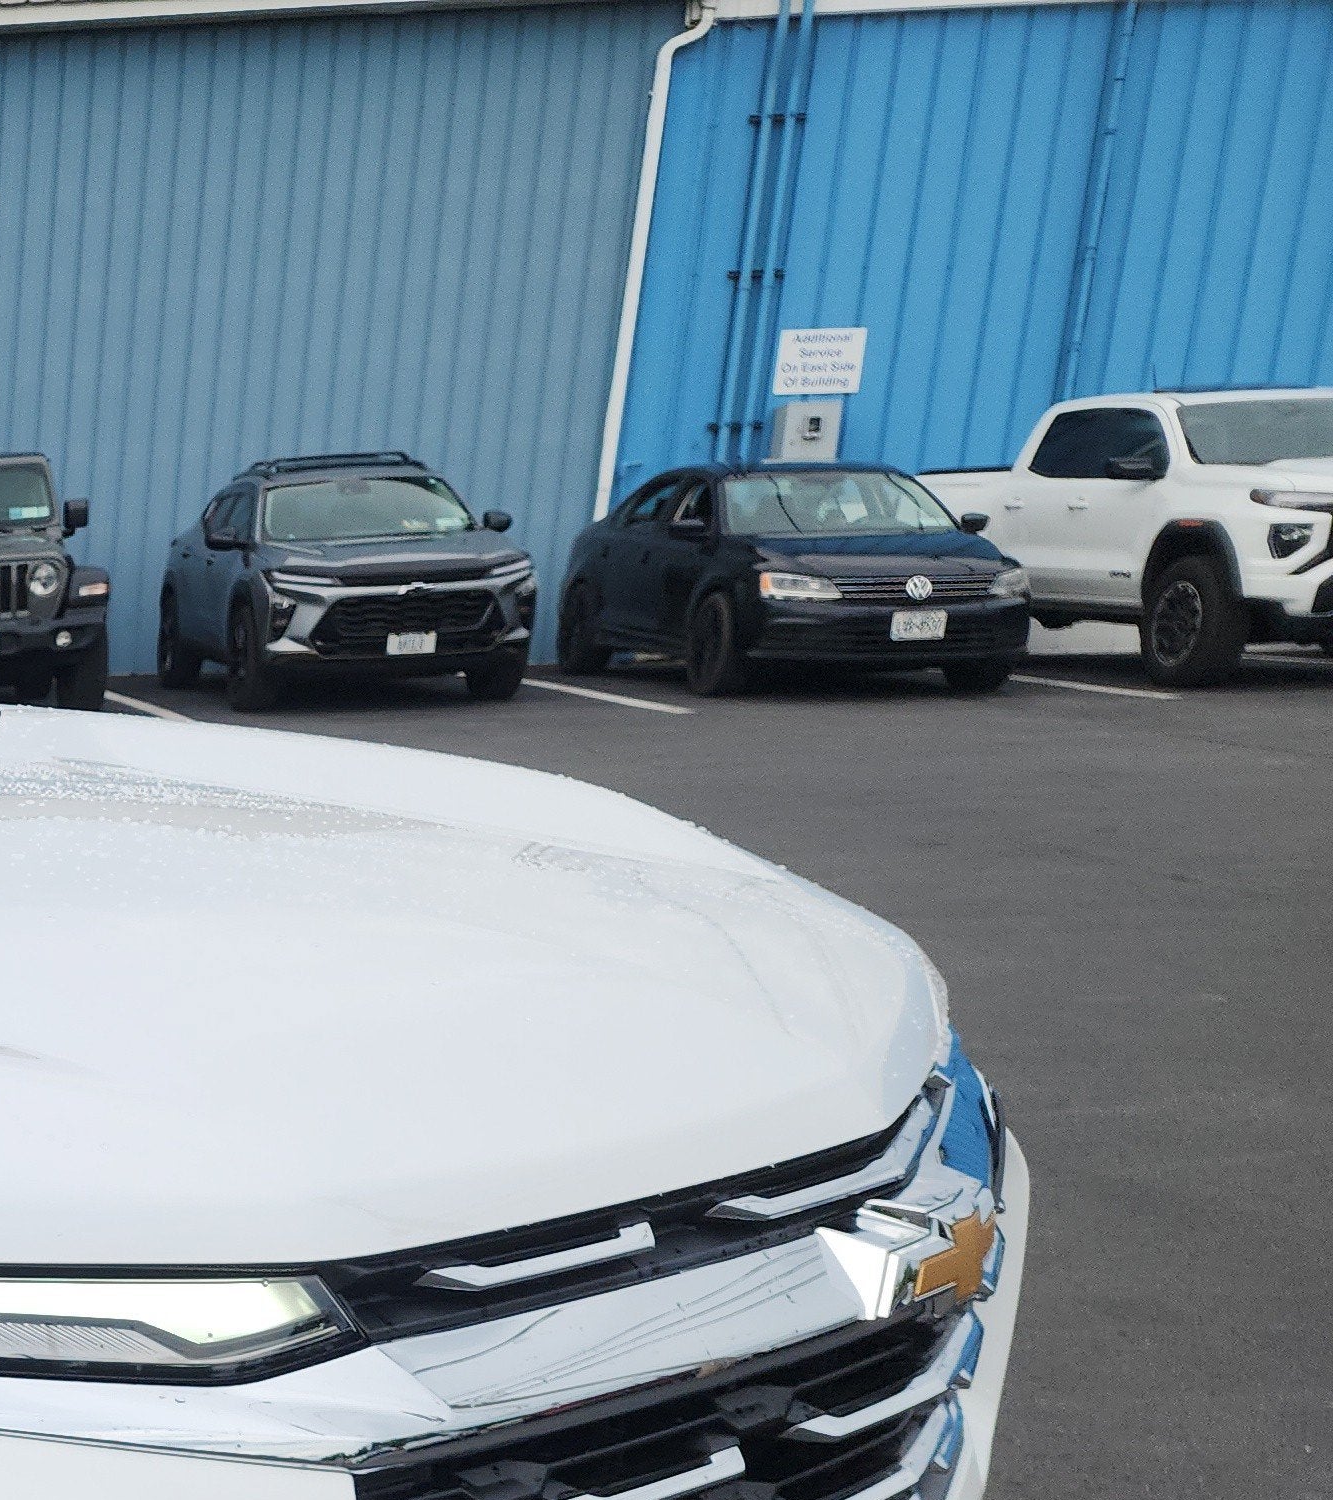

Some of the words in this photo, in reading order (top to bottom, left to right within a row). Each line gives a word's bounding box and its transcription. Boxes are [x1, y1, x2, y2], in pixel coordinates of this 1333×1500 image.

[799, 347, 843, 358] Service
[781, 362, 798, 373] On
[830, 361, 857, 371] Side
[801, 376, 850, 387] Building
